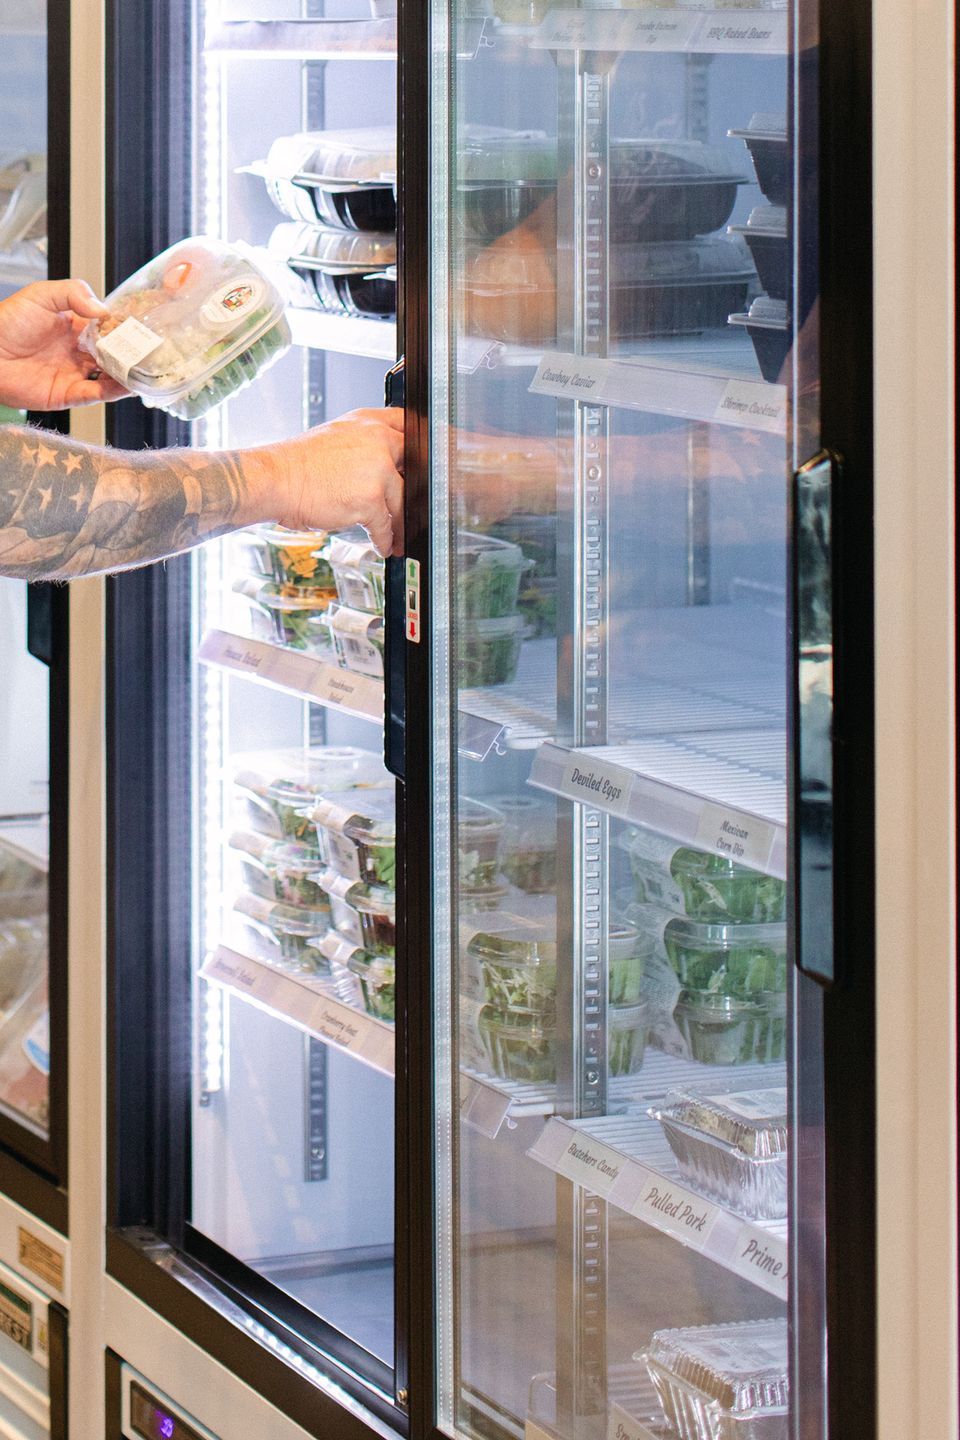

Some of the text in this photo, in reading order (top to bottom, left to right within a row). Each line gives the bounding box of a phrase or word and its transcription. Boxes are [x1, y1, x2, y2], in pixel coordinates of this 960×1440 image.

[541, 367, 596, 390] Cowboy Caviar
[571, 767, 622, 801] Deviled Eggs
[721, 820, 749, 839] Mexican
[716, 837, 745, 857] Corn Dip
[567, 1142, 620, 1182] Butchers Candy
[644, 1186, 708, 1233] Pulled Pork
[740, 1239, 783, 1276] Prime
